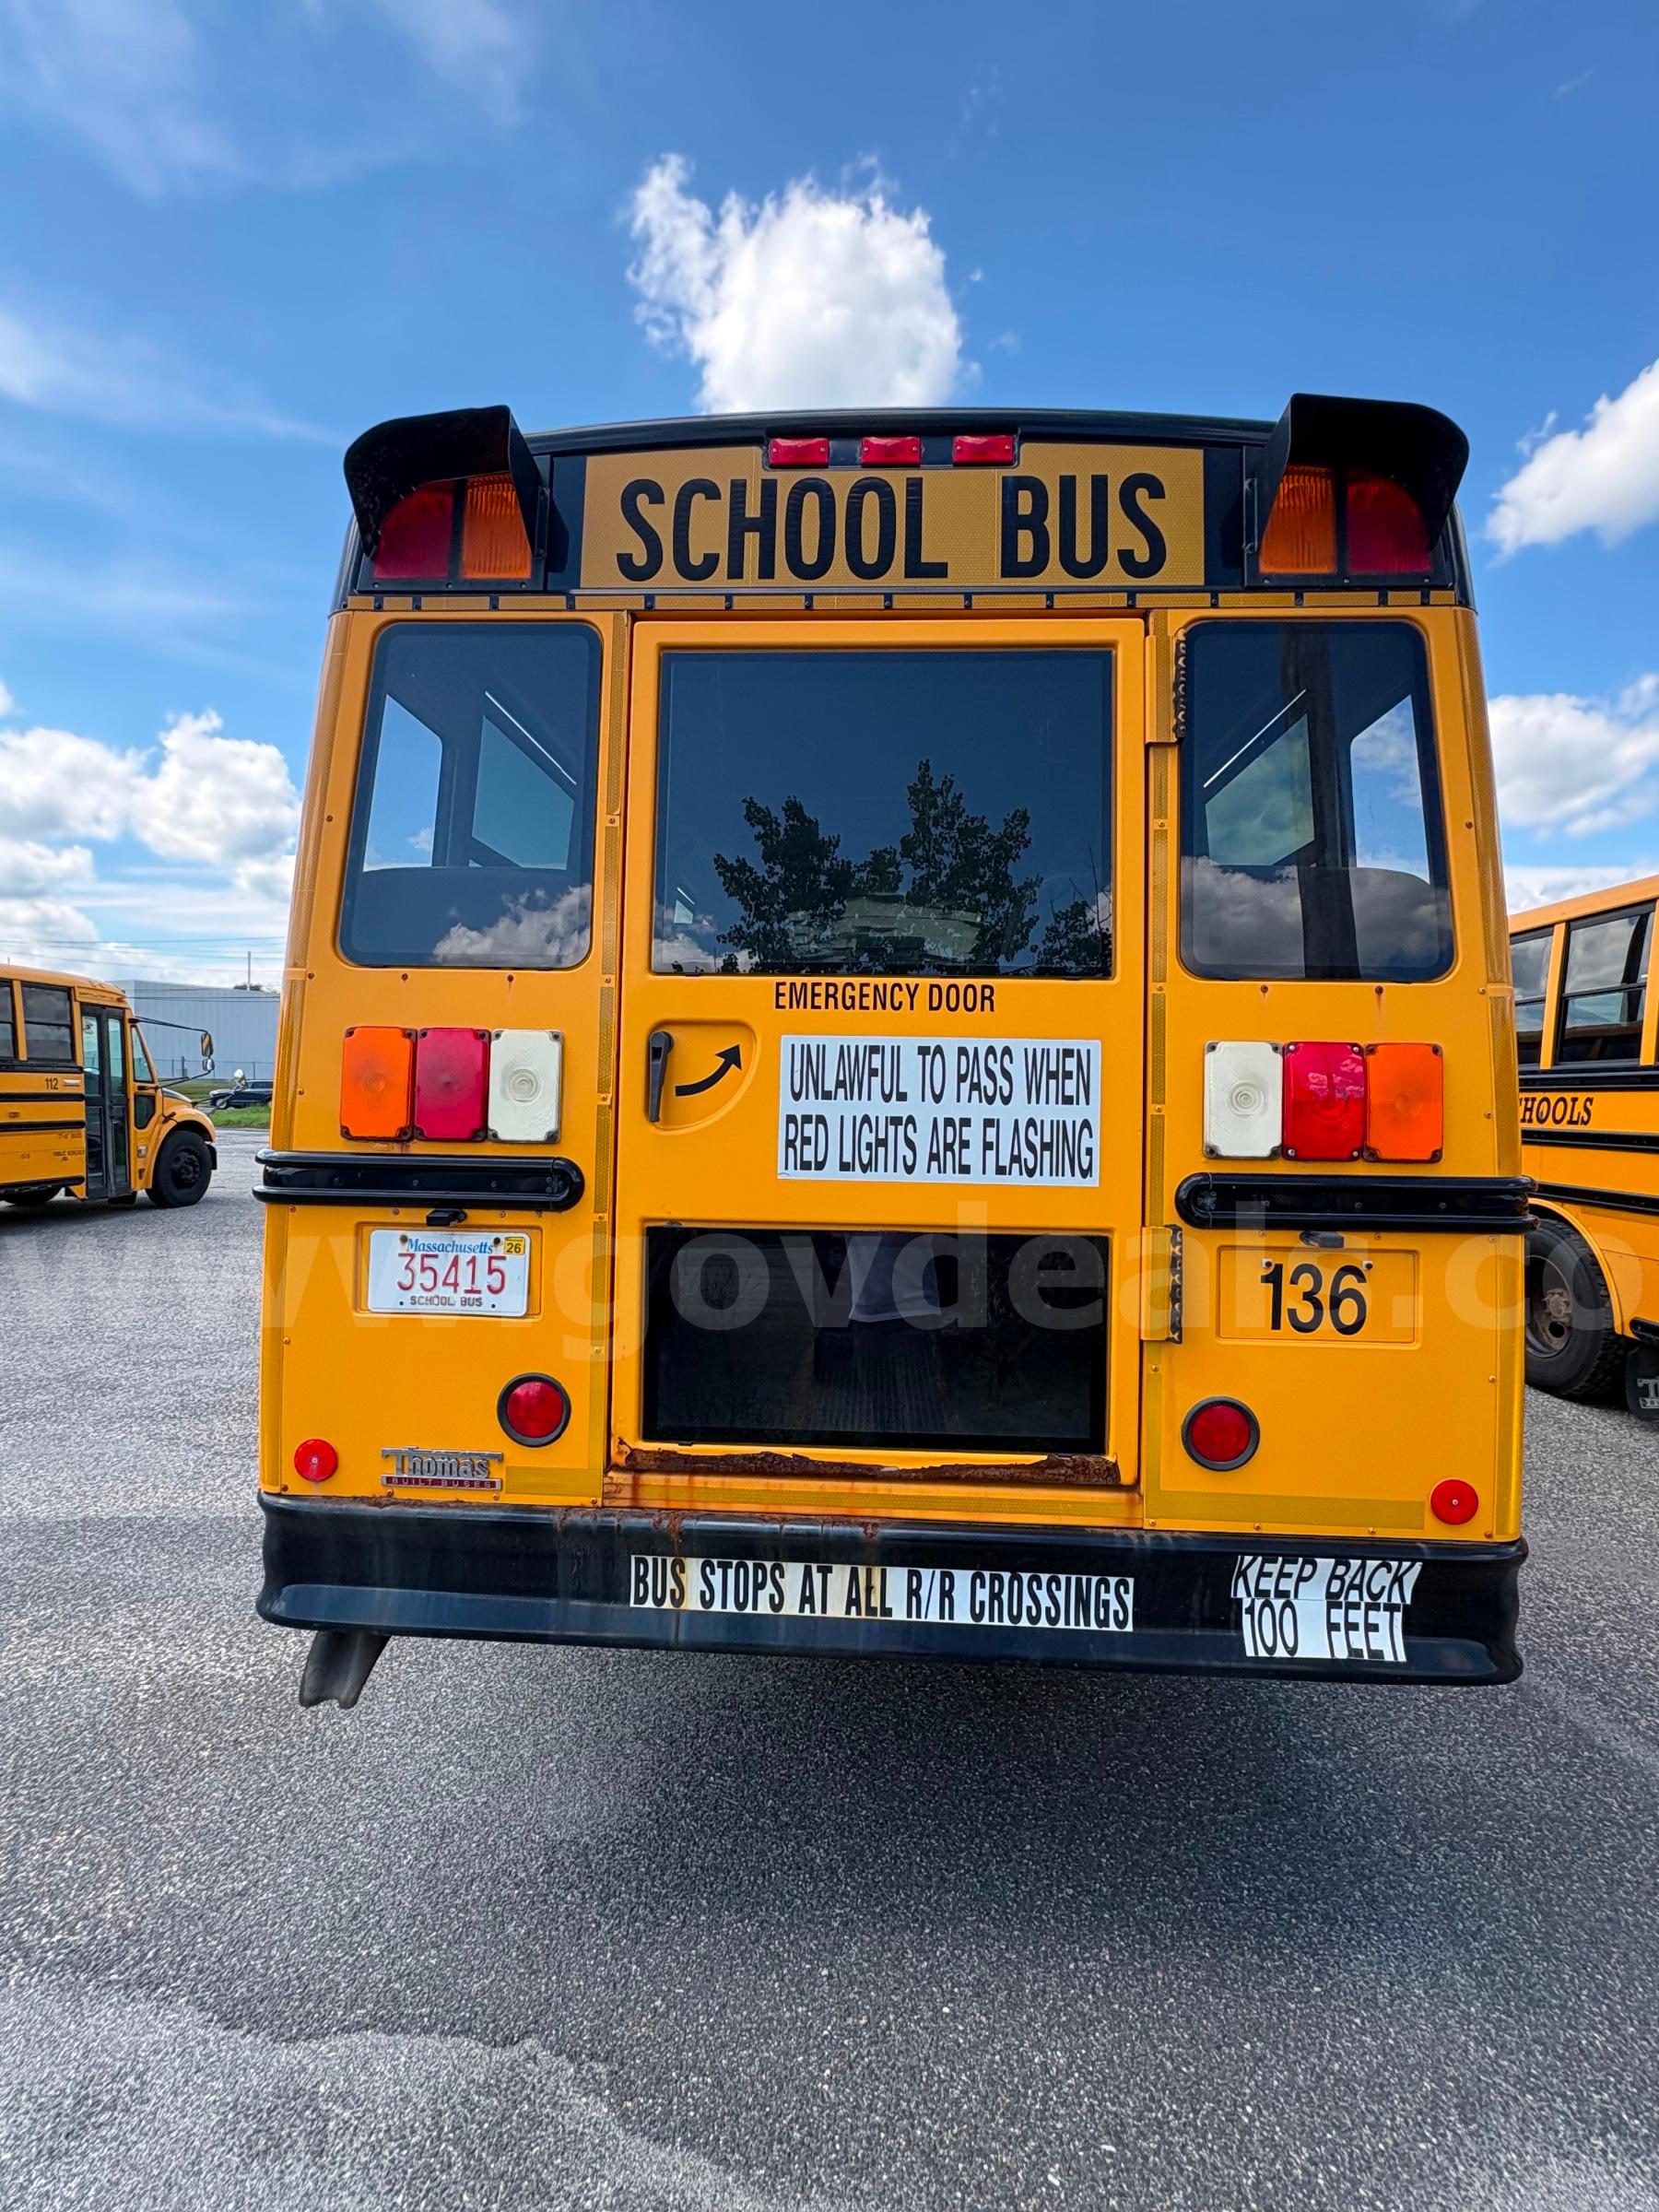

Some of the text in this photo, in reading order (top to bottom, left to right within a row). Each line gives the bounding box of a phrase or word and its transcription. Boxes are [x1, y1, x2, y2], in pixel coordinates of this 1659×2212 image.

[616, 472, 1168, 582] SCHOOL BUS
[774, 982, 995, 1013] EMERGENCY DOOR
[44, 1077, 59, 1090] 112
[789, 1043, 1091, 1107] UNLAWFUL TO PASS WHEN
[1519, 1096, 1594, 1126] HOOLS
[784, 1113, 1094, 1179] RED LIGHTS ARE FLASHING
[406, 1238, 494, 1254] Massachusetts
[506, 1242, 522, 1253] 26
[397, 1253, 507, 1295] 35415
[410, 1295, 483, 1307] SCHOOL BUS
[1261, 1263, 1367, 1336] 136
[381, 1445, 503, 1479] Thomas
[392, 1477, 491, 1488] BUILT BUSES
[634, 1556, 1130, 1630] BUS STOPS AT ALL R/R CROSSINGS
[1233, 1556, 1418, 1603] KEEP BACK
[1243, 1598, 1403, 1662] 100 FEET
